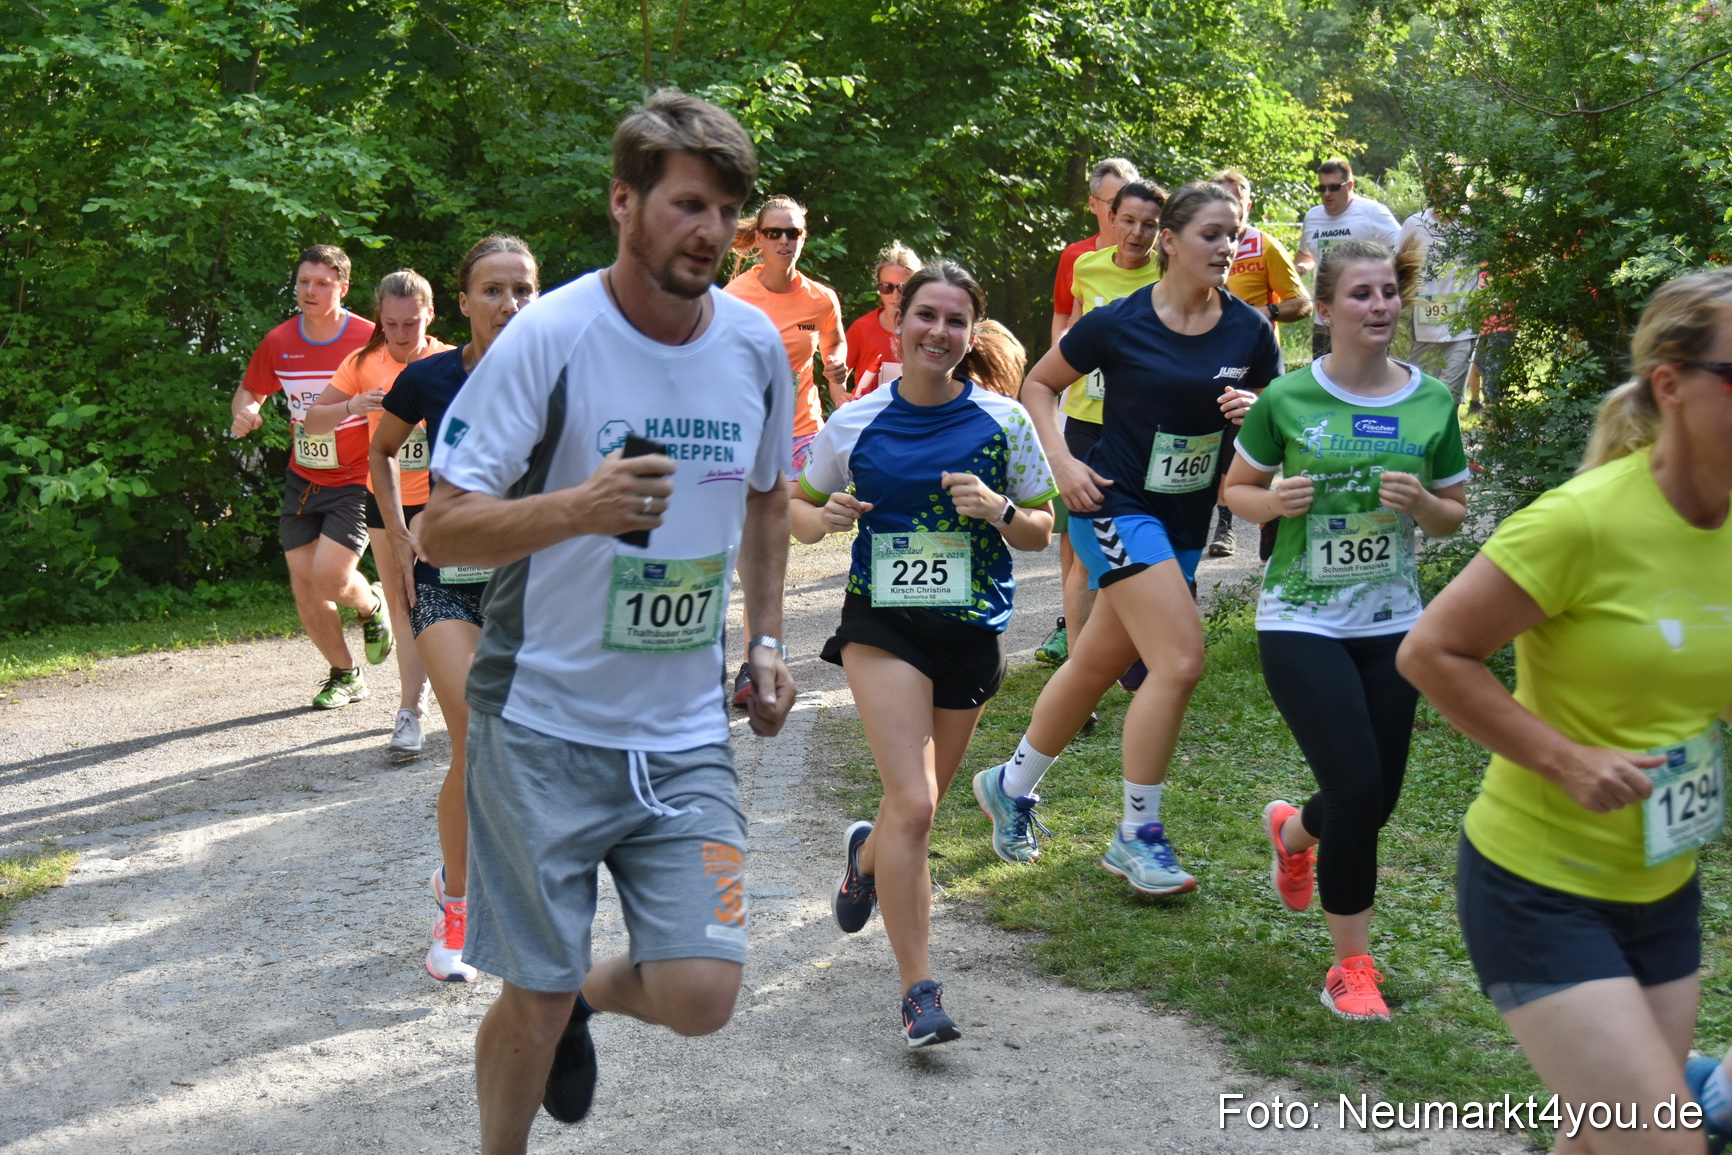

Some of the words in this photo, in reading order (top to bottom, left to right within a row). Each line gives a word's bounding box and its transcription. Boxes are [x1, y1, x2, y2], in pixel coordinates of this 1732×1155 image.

[1319, 228, 1351, 238] MAGNA
[1229, 261, 1264, 276] BÖGL
[1425, 305, 1448, 316] 993
[1294, 415, 1307, 426] 10
[1362, 423, 1396, 431] Fischer
[645, 418, 742, 442] HAUBNER
[298, 440, 329, 457] 1830
[666, 443, 734, 462] REPPEN
[1329, 451, 1378, 459] neumarkt
[1161, 454, 1211, 477] 1460
[1300, 466, 1362, 481] Gesunde
[1324, 480, 1371, 493] laufen
[1320, 535, 1390, 565] 1362
[892, 559, 948, 585] 225
[1322, 565, 1353, 573] Schmidt
[1355, 562, 1389, 571] Franziska
[916, 586, 951, 594] Christina
[626, 589, 713, 627] 1007
